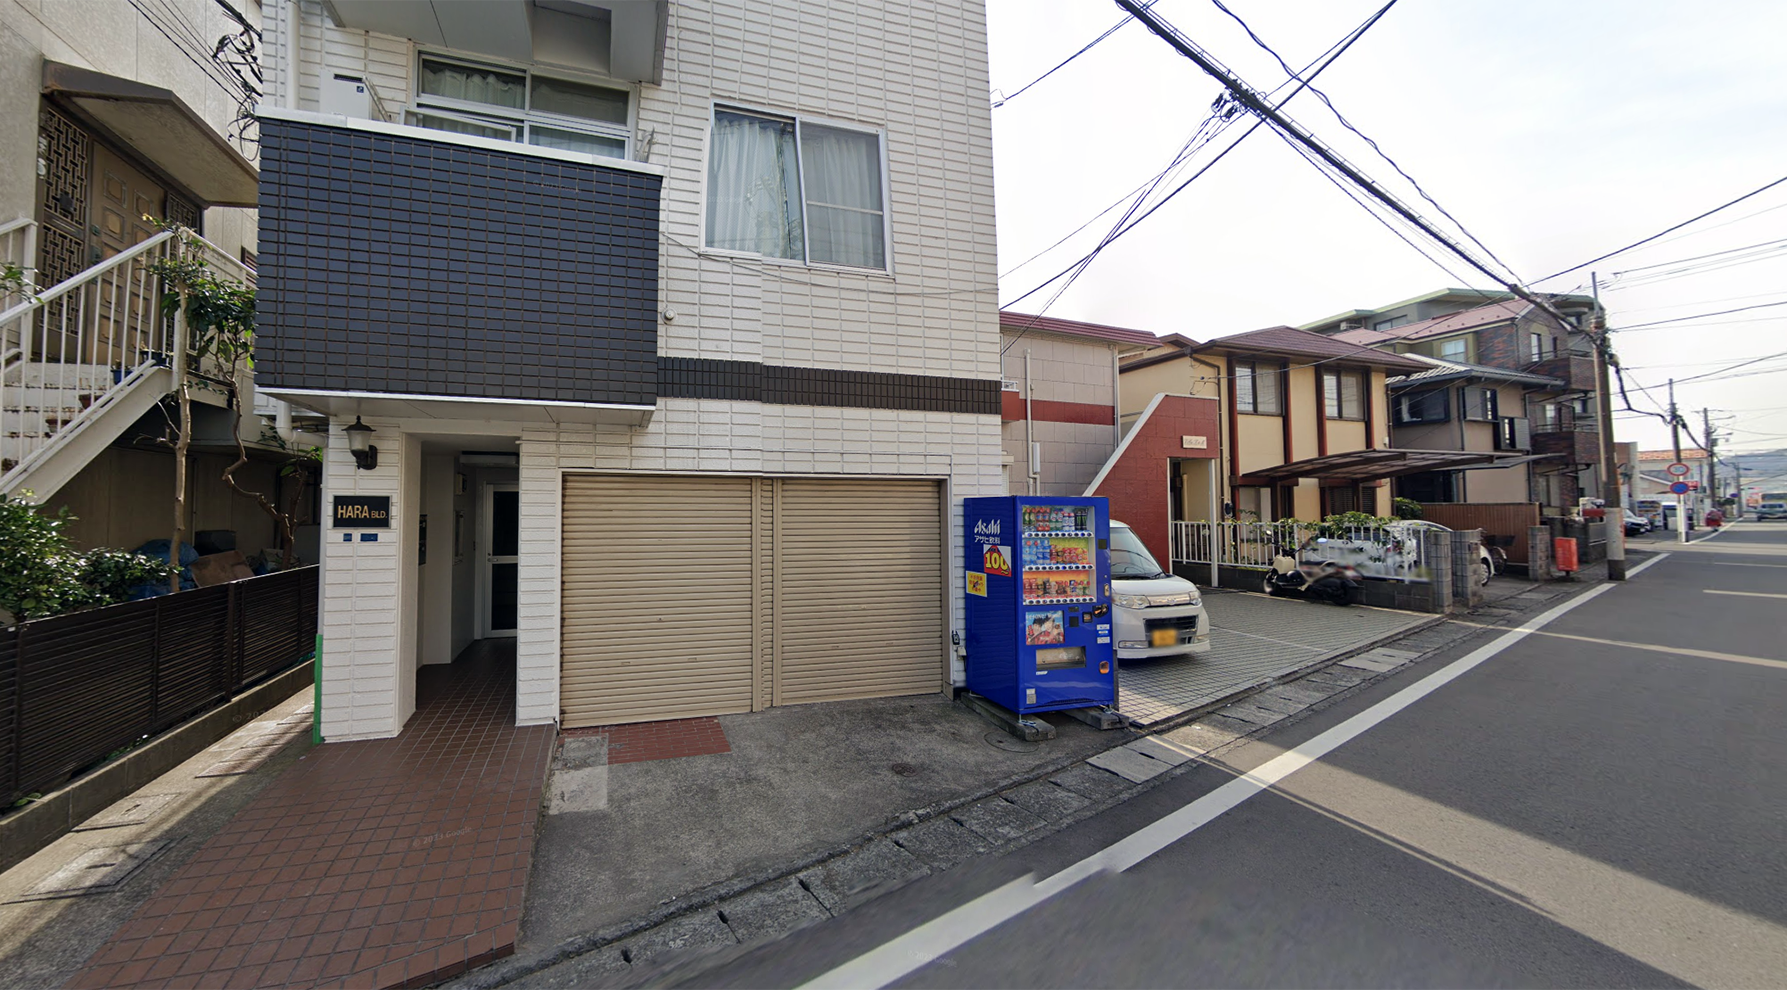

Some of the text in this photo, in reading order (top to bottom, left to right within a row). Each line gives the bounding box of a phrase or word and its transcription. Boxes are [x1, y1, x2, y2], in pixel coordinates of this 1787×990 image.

[337, 505, 387, 519] HARA BLD.
[974, 518, 1001, 535] Asahi
[974, 535, 1001, 544] アサヒ飲料
